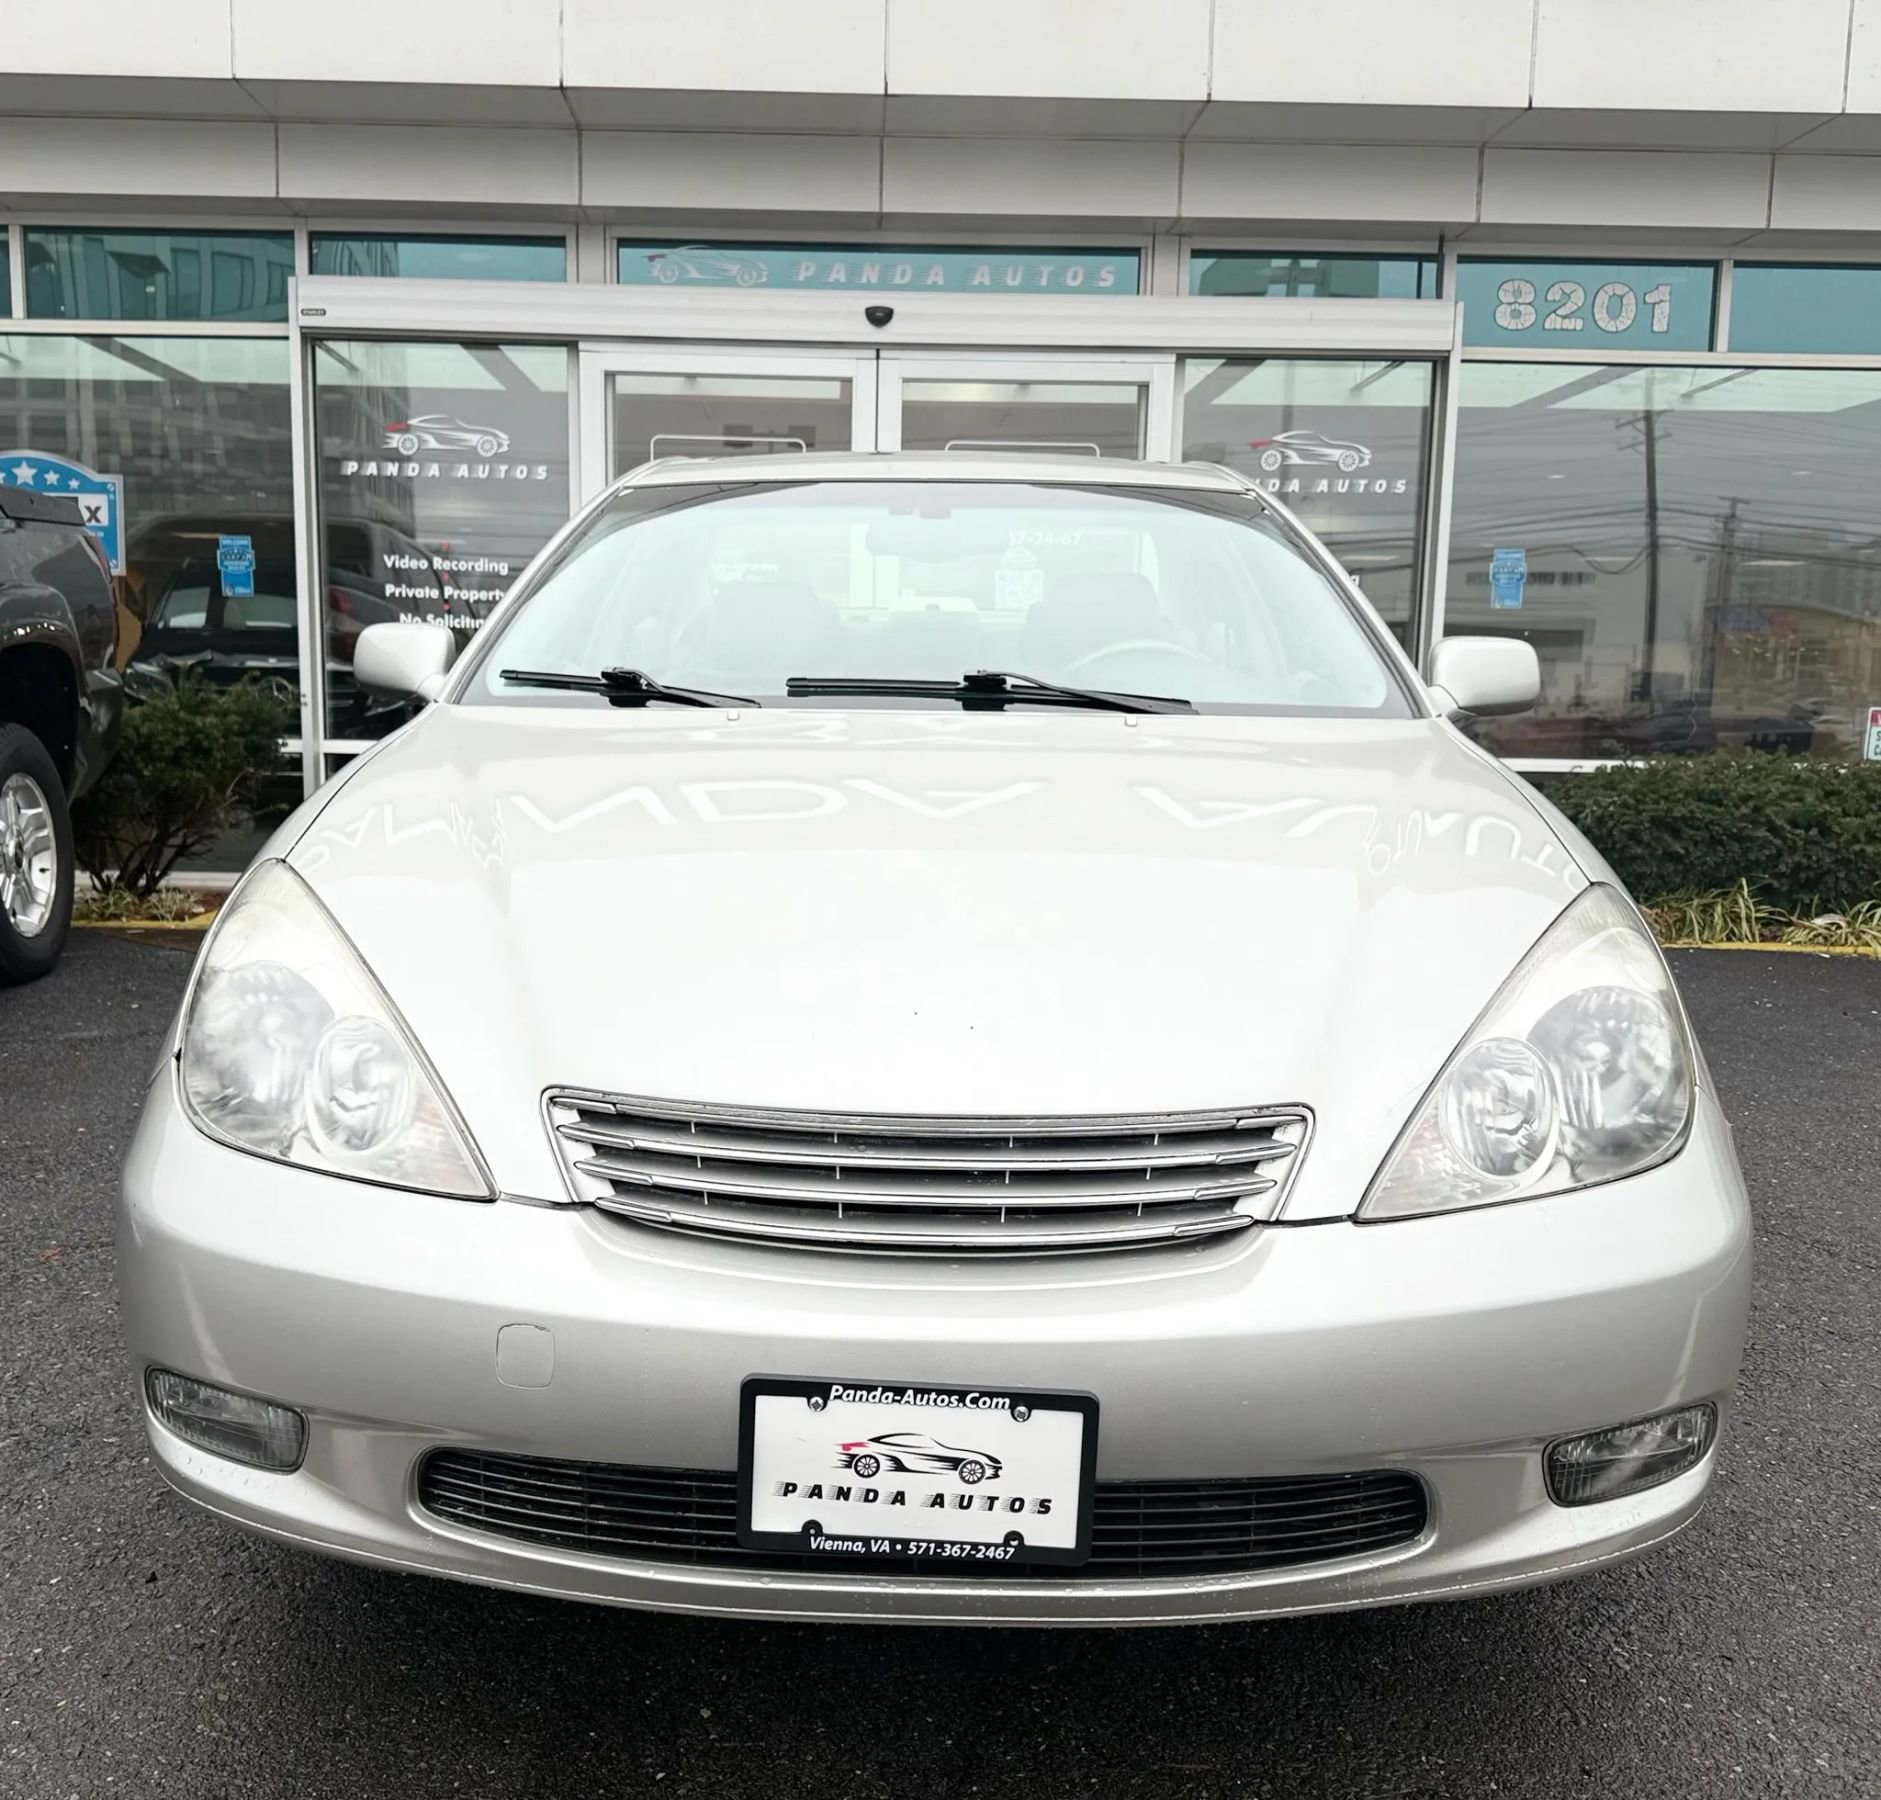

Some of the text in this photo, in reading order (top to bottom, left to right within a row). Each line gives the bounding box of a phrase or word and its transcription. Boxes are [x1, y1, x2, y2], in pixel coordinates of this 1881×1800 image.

[796, 261, 1116, 288] PANDA AUTOS
[1493, 278, 1672, 334] 8201
[344, 461, 548, 480] PANDA AUTOS
[1316, 478, 1408, 494] AUTOS
[383, 554, 509, 576] Video Recording
[385, 584, 440, 599] Private
[828, 1384, 1011, 1411] Panda-Autos.Com
[779, 1481, 1052, 1516] PANDA AUTOS
[809, 1536, 1016, 1560] Vienna, VA 571-367-2467
